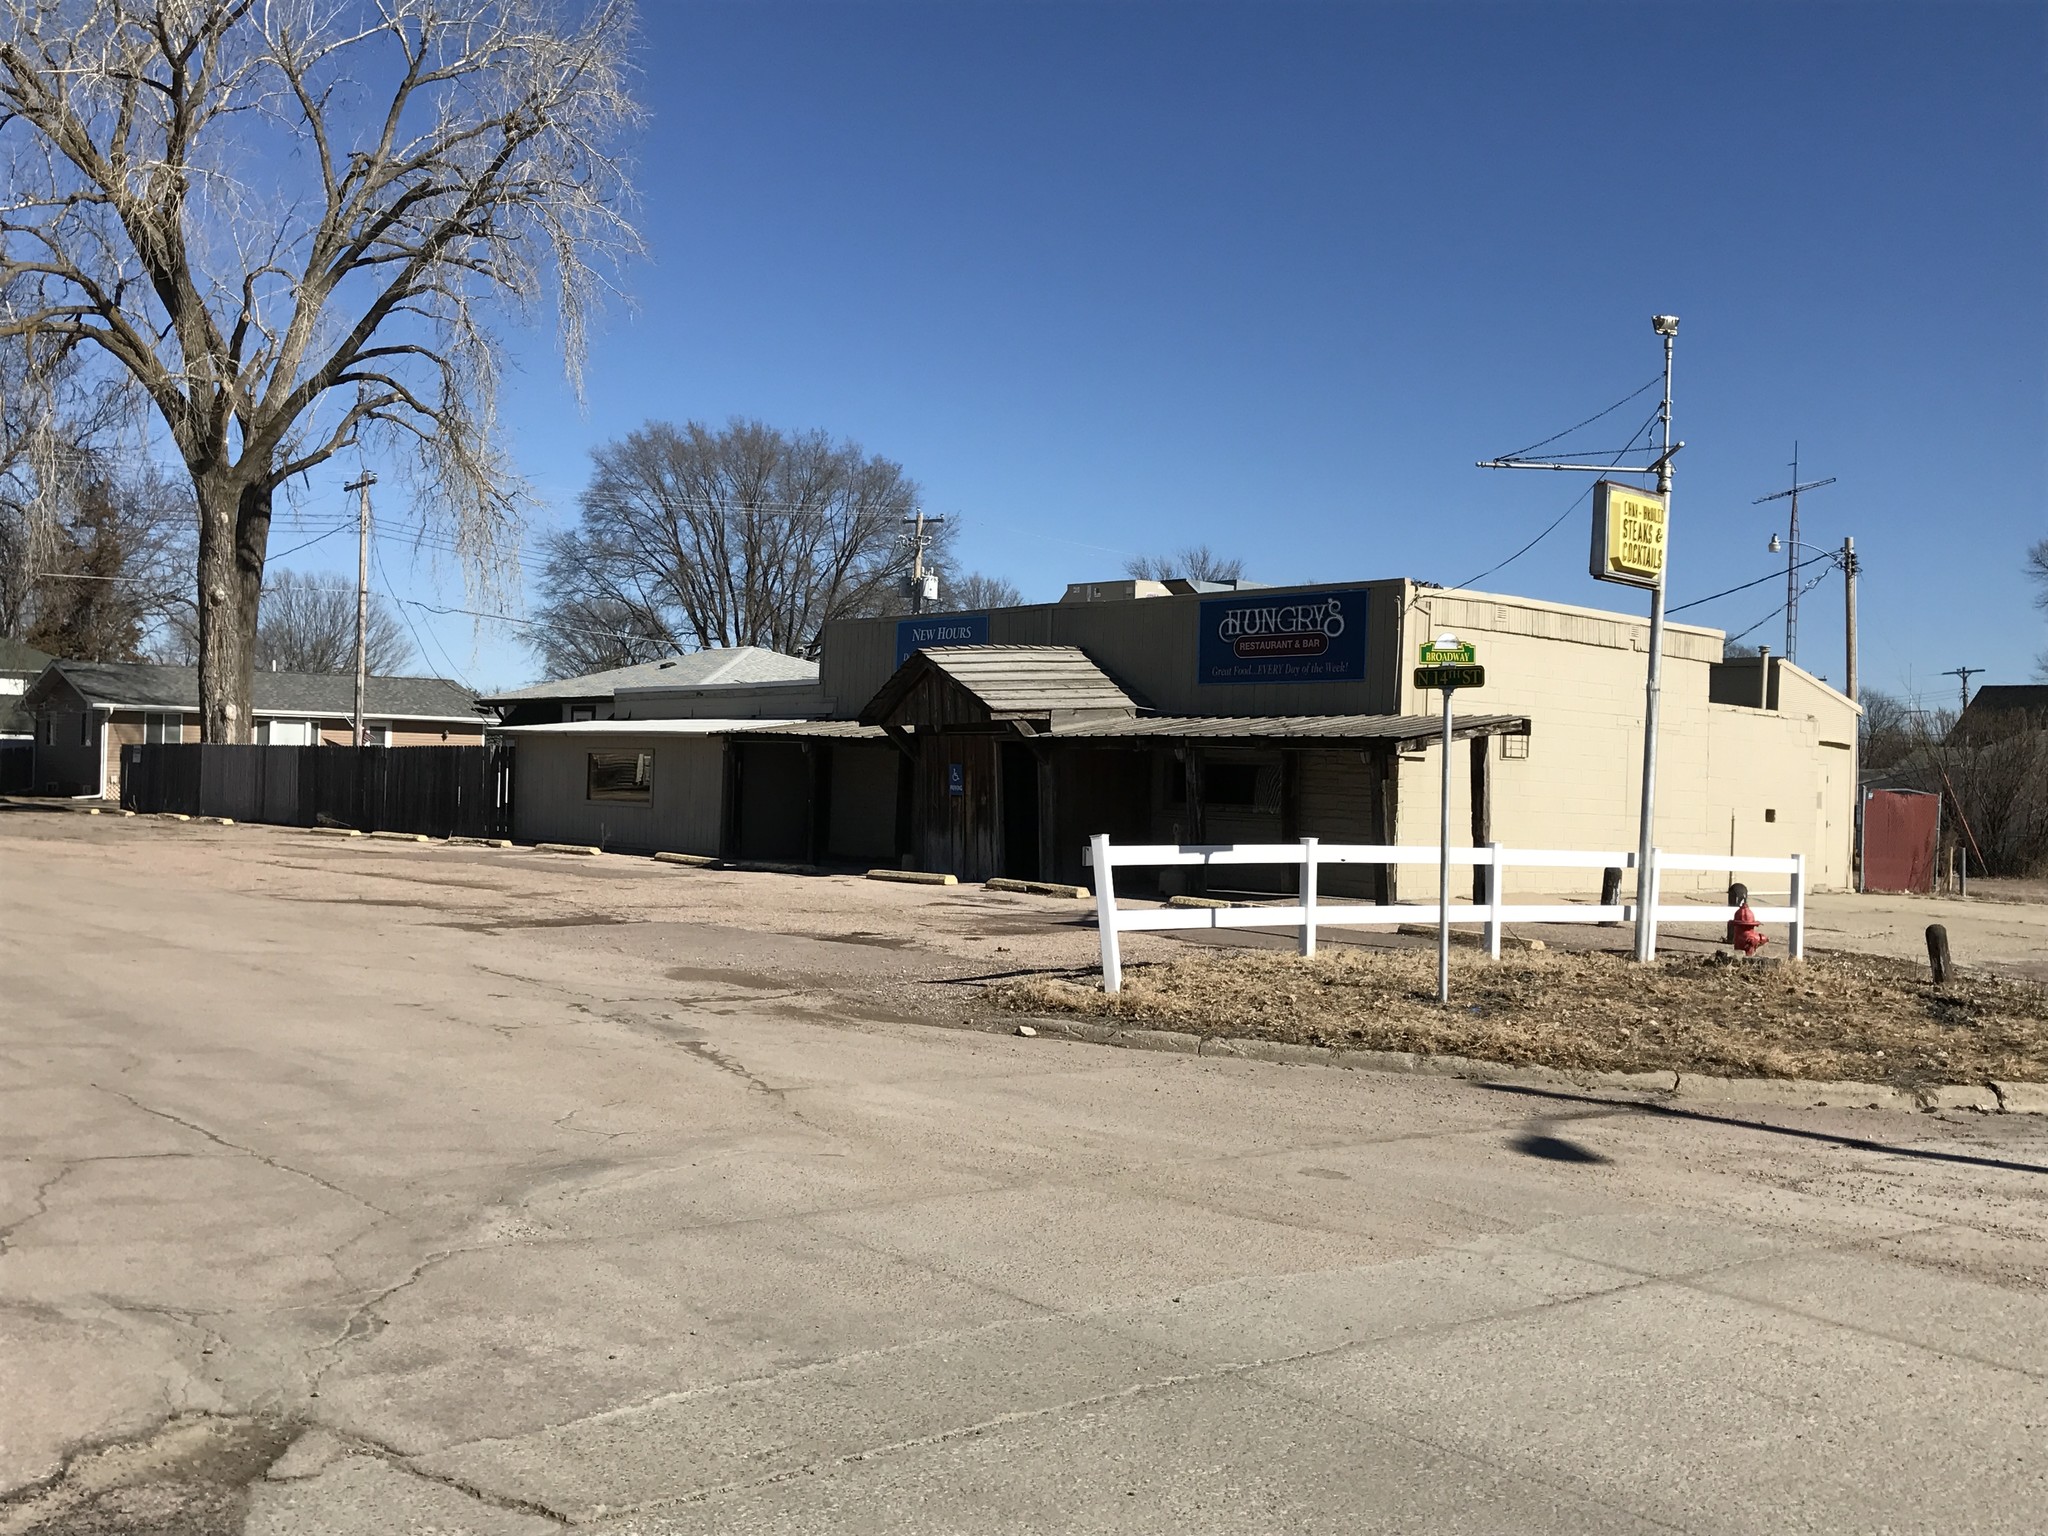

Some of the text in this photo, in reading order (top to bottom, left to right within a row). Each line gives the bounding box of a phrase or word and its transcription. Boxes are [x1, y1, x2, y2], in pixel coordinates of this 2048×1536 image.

[1623, 518, 1662, 544] STEAKS &
[1622, 542, 1662, 569] COCKTAILS
[1219, 598, 1345, 643] HUNGRY'S
[912, 626, 972, 642] NEW HOURS
[1239, 639, 1320, 651] RESTAURANT & BAR
[1426, 652, 1469, 661] BROADWAY
[1212, 666, 1232, 676] Great
[1285, 664, 1300, 676] Day
[1301, 663, 1310, 675] of
[1312, 662, 1323, 673] the
[1325, 661, 1349, 673] Week!
[1417, 669, 1480, 685] N 14TH ST
